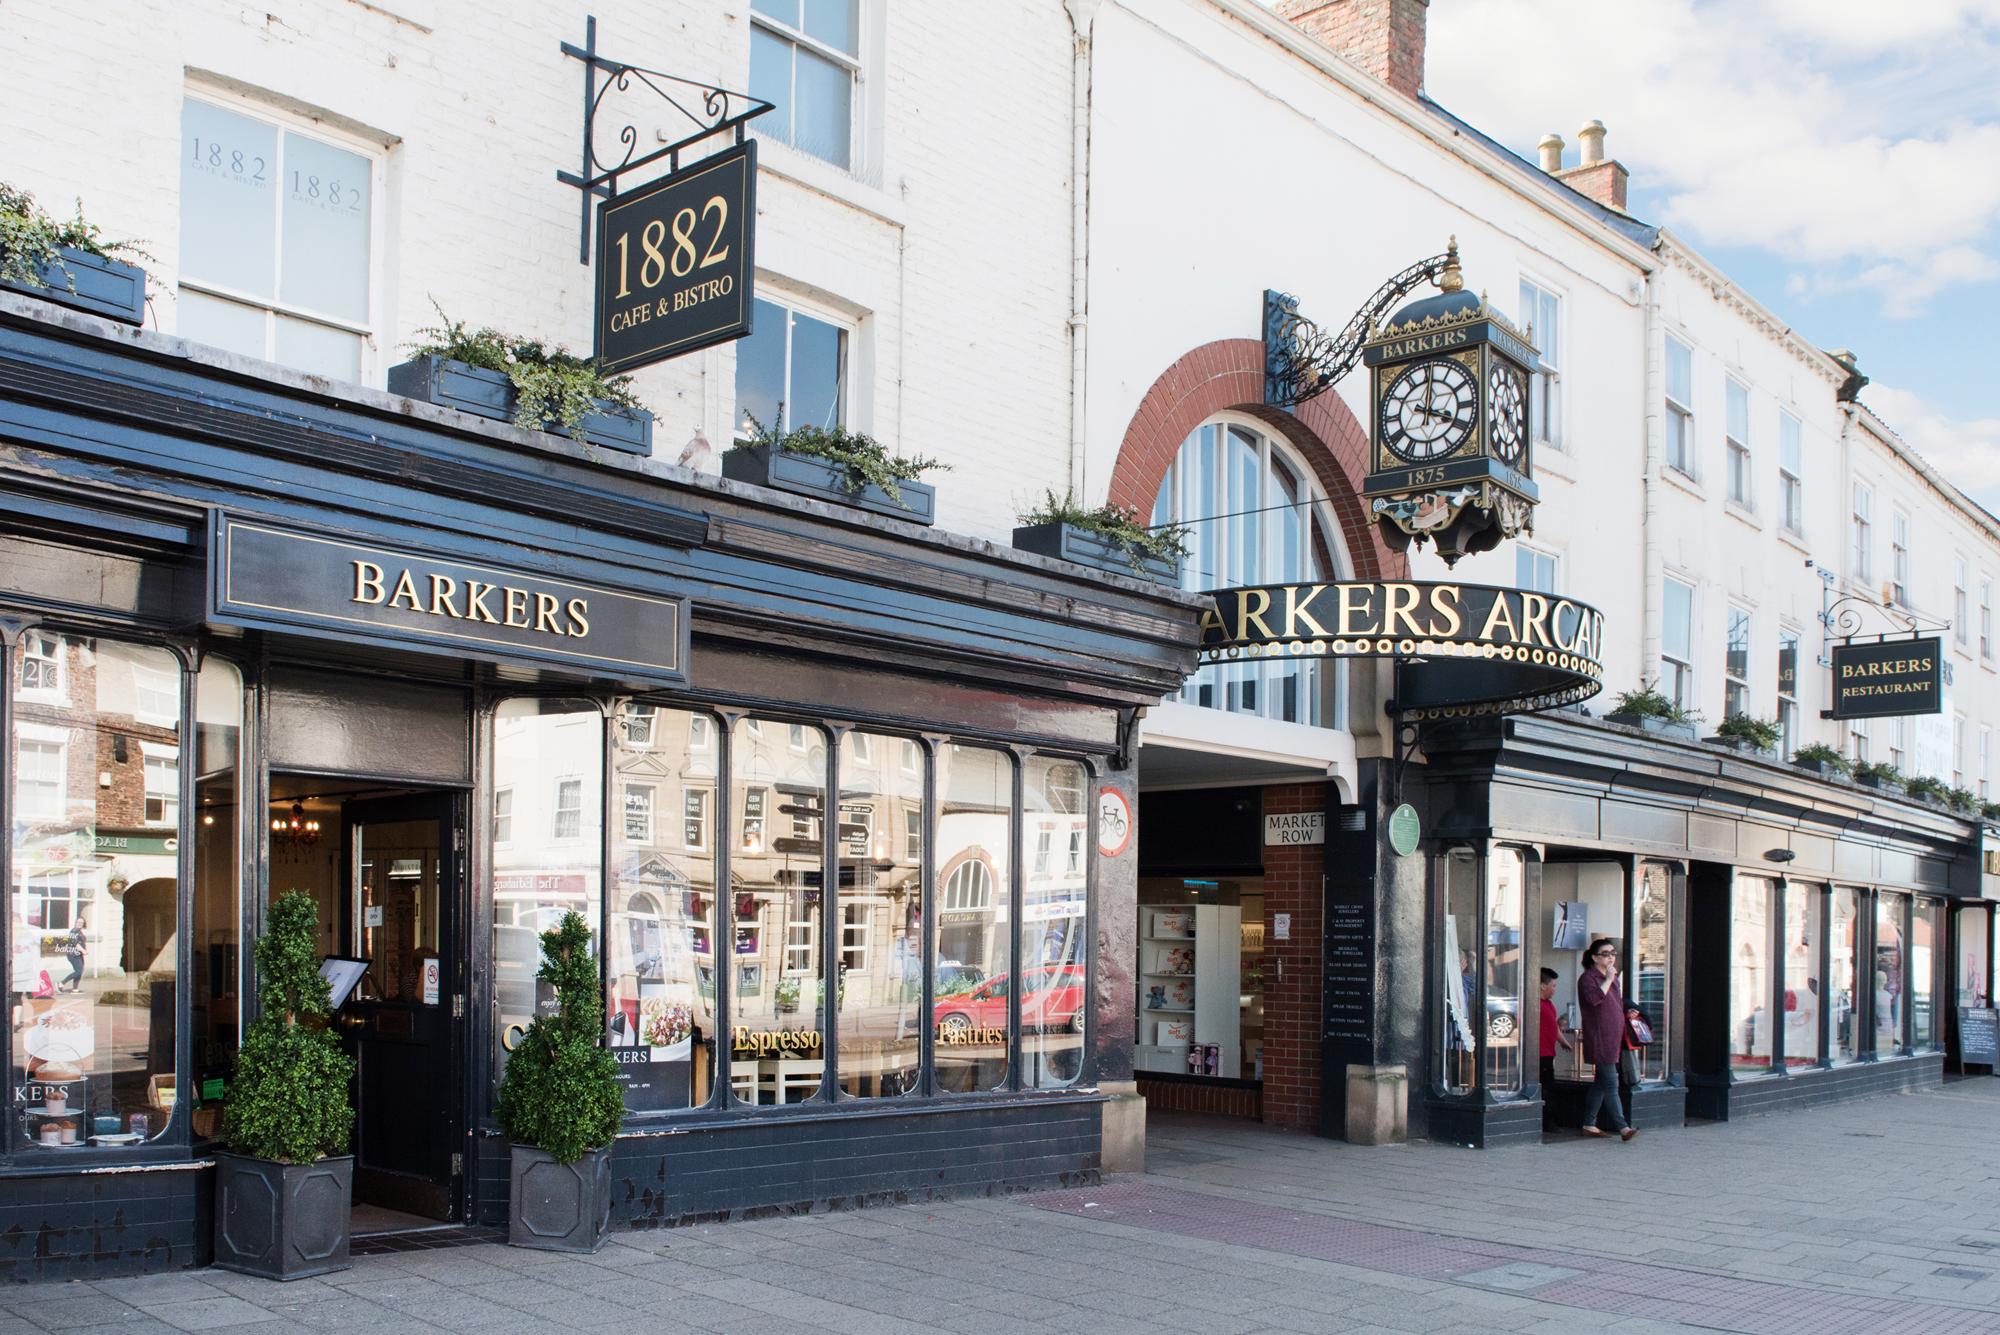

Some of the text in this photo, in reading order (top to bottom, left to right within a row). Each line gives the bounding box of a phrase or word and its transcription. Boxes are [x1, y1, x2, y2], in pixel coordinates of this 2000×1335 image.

[192, 138, 265, 181] 1882
[294, 170, 360, 212] 1882
[615, 195, 729, 299] 1882
[611, 275, 733, 332] CAFE & BISTRO
[1383, 328, 1467, 359] BARKERS
[1407, 466, 1445, 486] 1875
[1506, 471, 1522, 489] 1875
[352, 560, 589, 638] BARKERS
[1842, 658, 1932, 679] BARKERS
[1842, 681, 1931, 697] RESTAURANT
[1269, 814, 1325, 829] MARKET
[1282, 830, 1313, 843] ROW
[733, 1025, 820, 1057] Espresso
[937, 1021, 1002, 1045] Pastries
